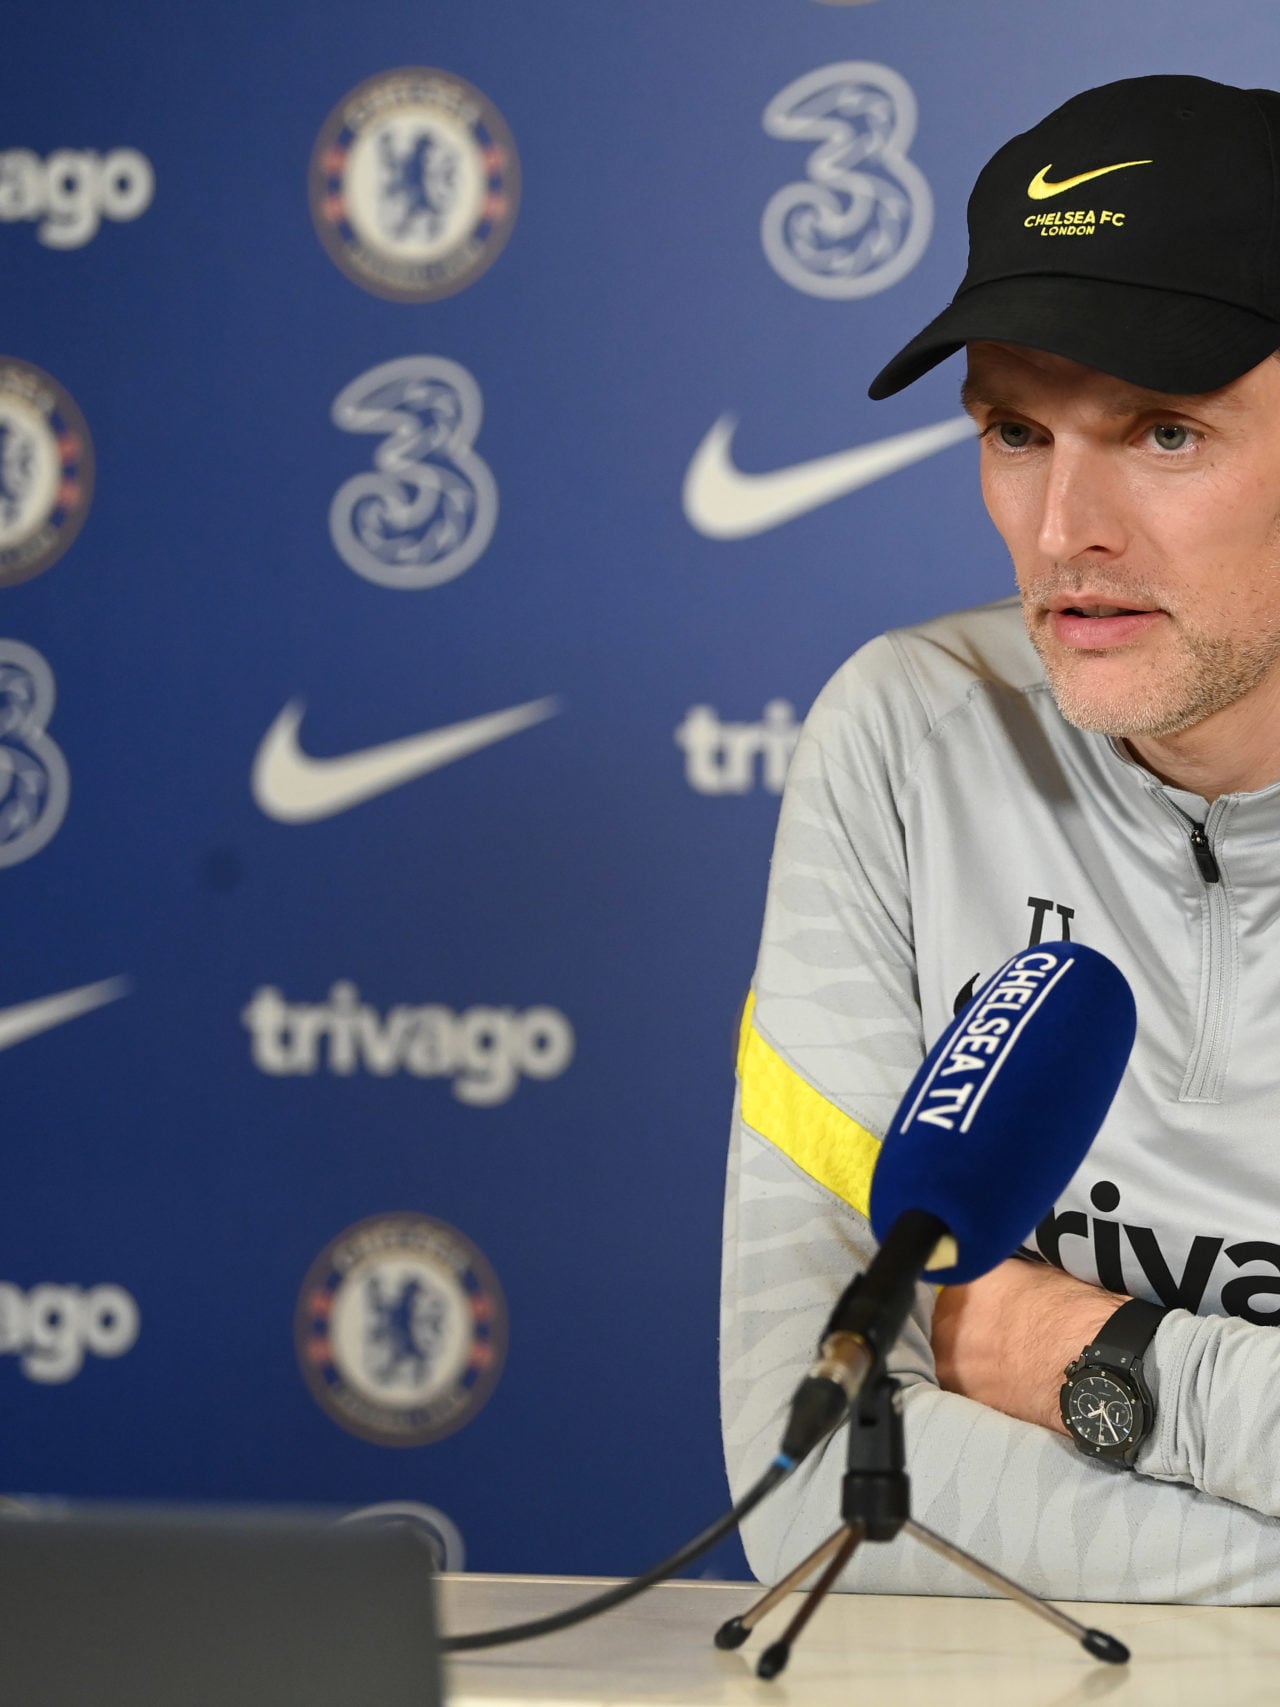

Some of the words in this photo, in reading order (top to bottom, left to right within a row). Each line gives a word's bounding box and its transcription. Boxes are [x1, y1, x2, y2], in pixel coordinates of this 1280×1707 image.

[1024, 210, 1095, 227] CHELSEA
[1100, 210, 1126, 226] FC
[1040, 226, 1095, 236] LONDON
[940, 952, 1058, 1077] CHELSEA
[242, 979, 575, 1107] trivago
[917, 1083, 974, 1130] TV
